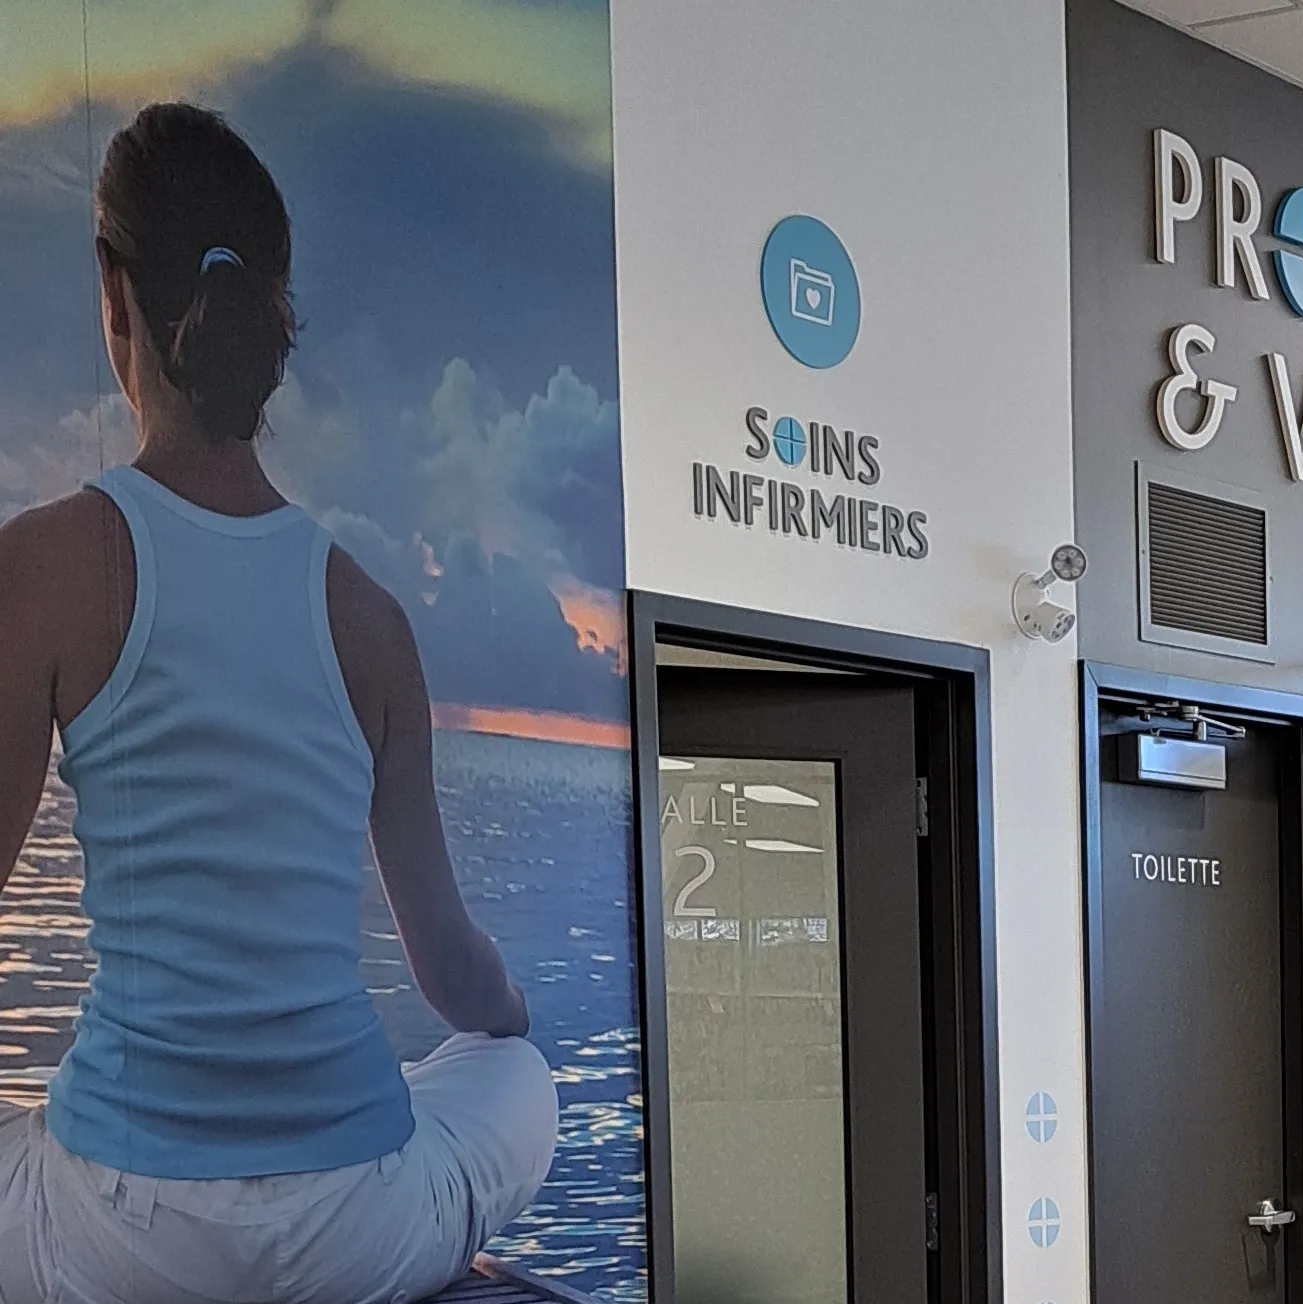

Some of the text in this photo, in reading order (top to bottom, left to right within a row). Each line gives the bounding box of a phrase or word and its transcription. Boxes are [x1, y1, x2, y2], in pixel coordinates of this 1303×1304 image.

[1156, 323, 1237, 450] &
[745, 406, 880, 485] SOINS
[692, 462, 929, 559] INFIRMIERS
[661, 795, 748, 826] ALLE
[673, 845, 717, 916] 2
[1131, 853, 1220, 886] TOILETTE
